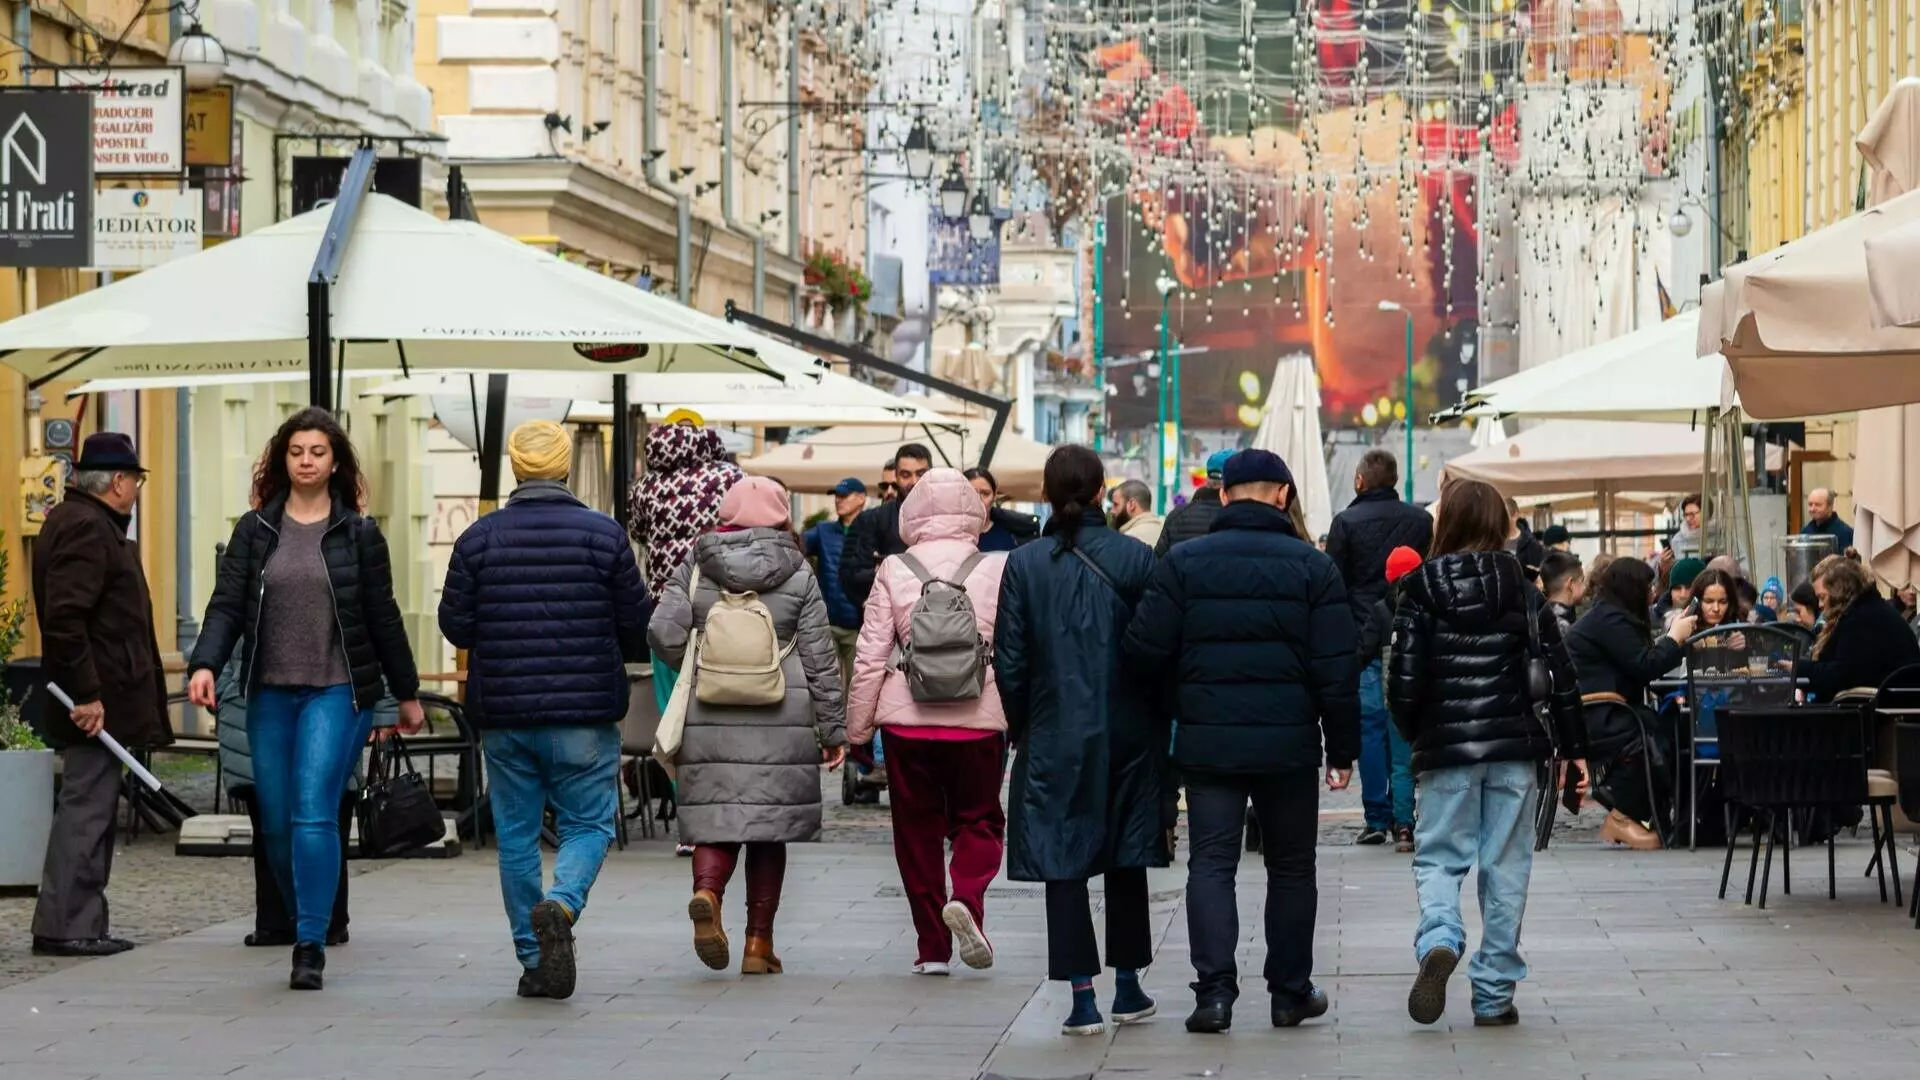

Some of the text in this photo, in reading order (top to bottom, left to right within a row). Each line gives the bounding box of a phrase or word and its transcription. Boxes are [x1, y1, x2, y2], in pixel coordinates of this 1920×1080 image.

[94, 107, 154, 118] RADUCERI
[186, 112, 208, 132] AT
[95, 152, 170, 164] NSFER VIDEO
[16, 190, 75, 231] Frati
